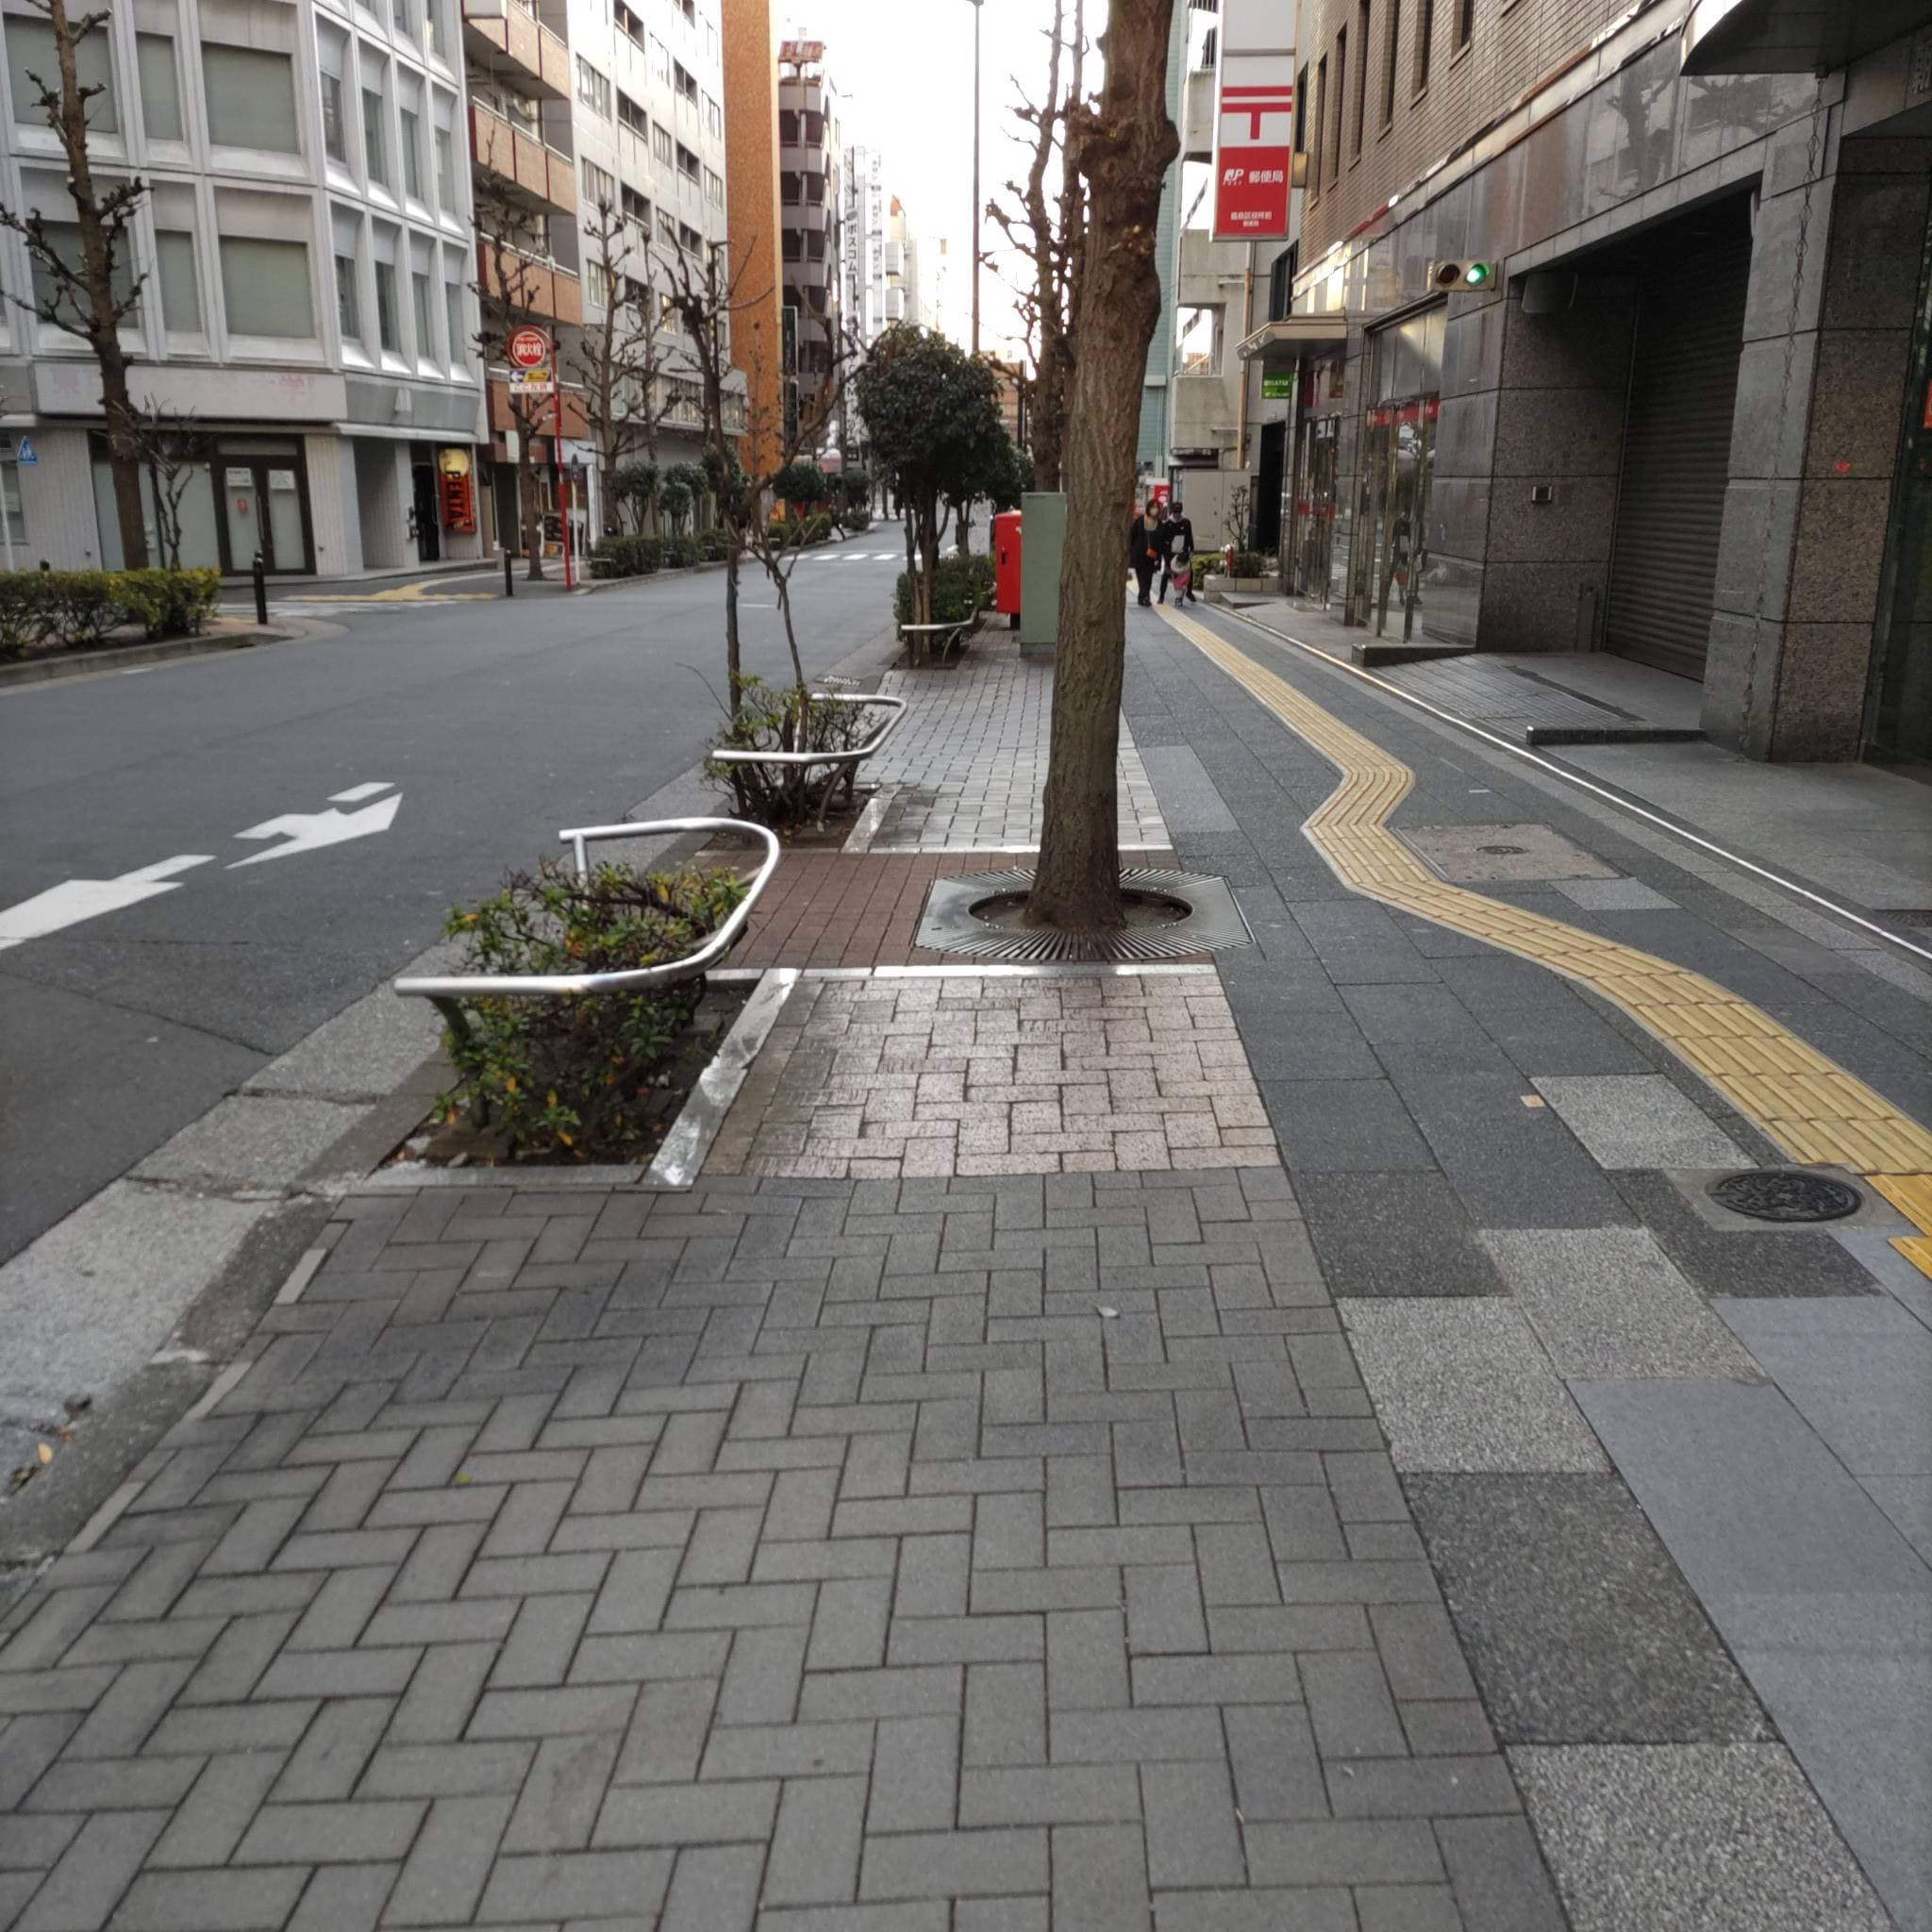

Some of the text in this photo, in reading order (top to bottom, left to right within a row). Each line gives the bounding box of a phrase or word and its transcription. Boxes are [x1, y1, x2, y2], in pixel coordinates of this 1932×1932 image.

[1249, 170, 1284, 184] 郵便局
[516, 342, 542, 358] 消火栓
